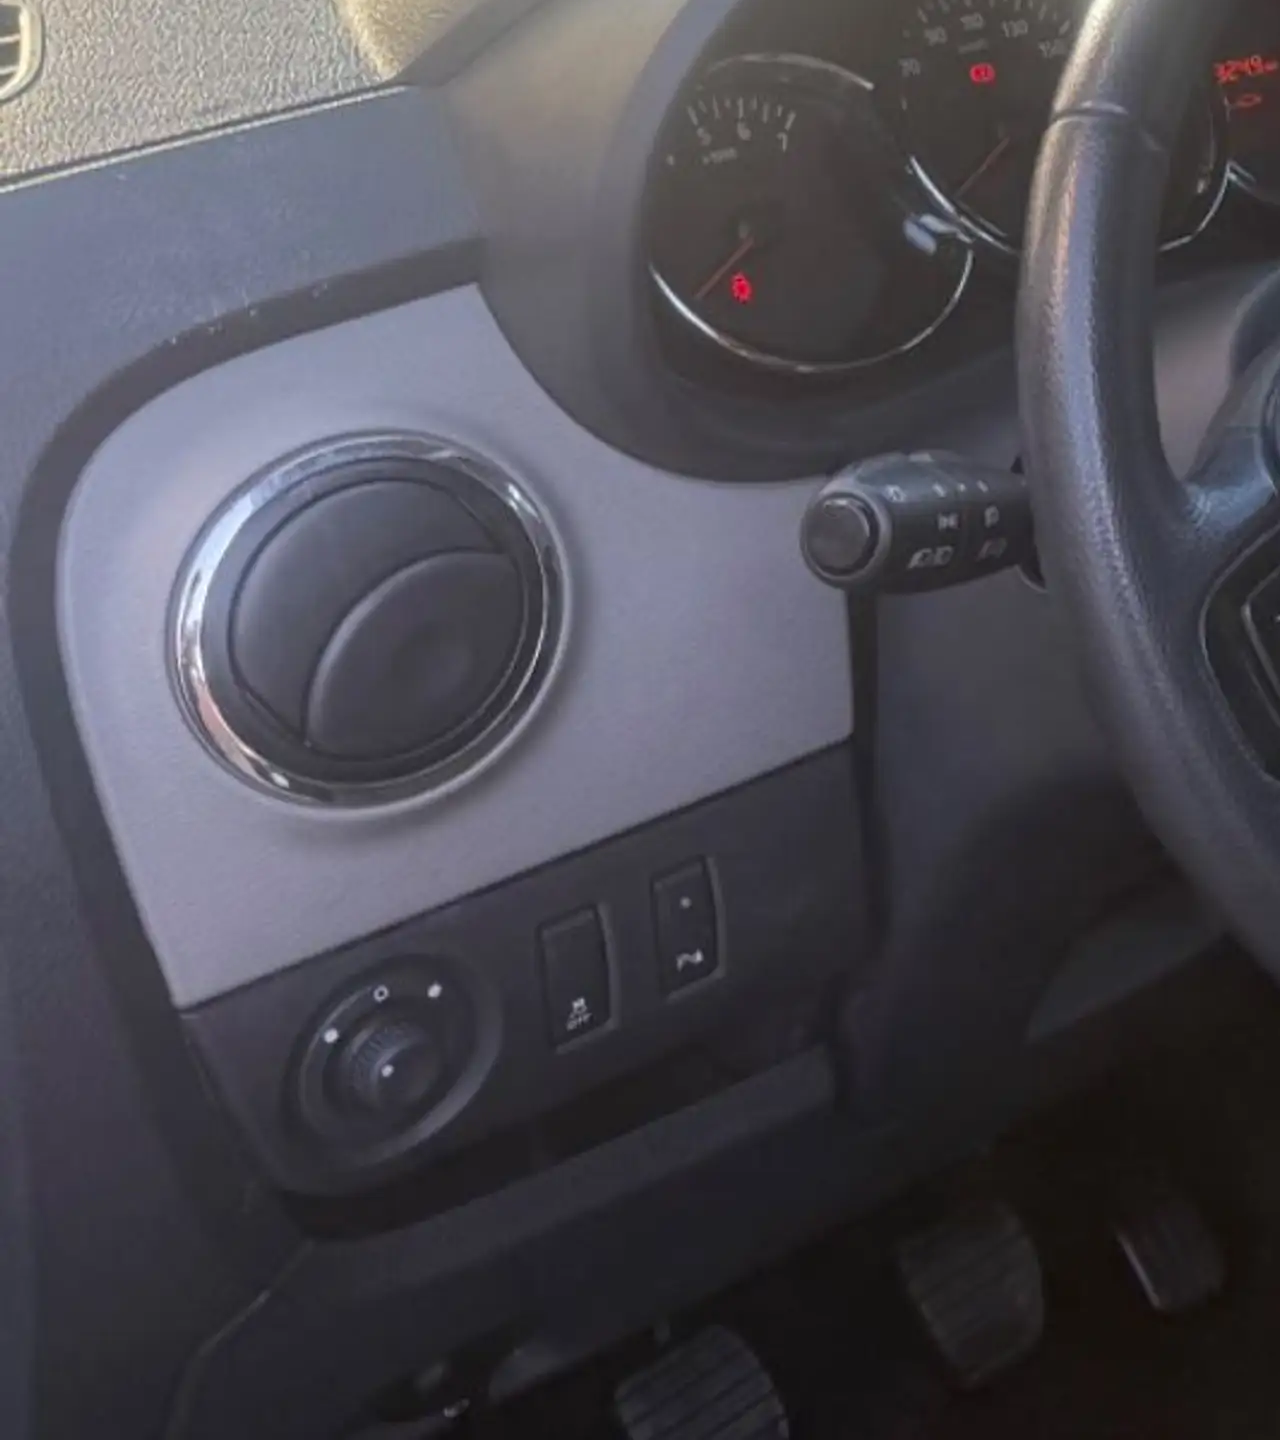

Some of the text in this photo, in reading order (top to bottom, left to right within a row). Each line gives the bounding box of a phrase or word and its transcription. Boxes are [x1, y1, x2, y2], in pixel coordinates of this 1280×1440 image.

[695, 126, 713, 147] 5
[735, 120, 753, 142] 6
[775, 131, 789, 153] 7
